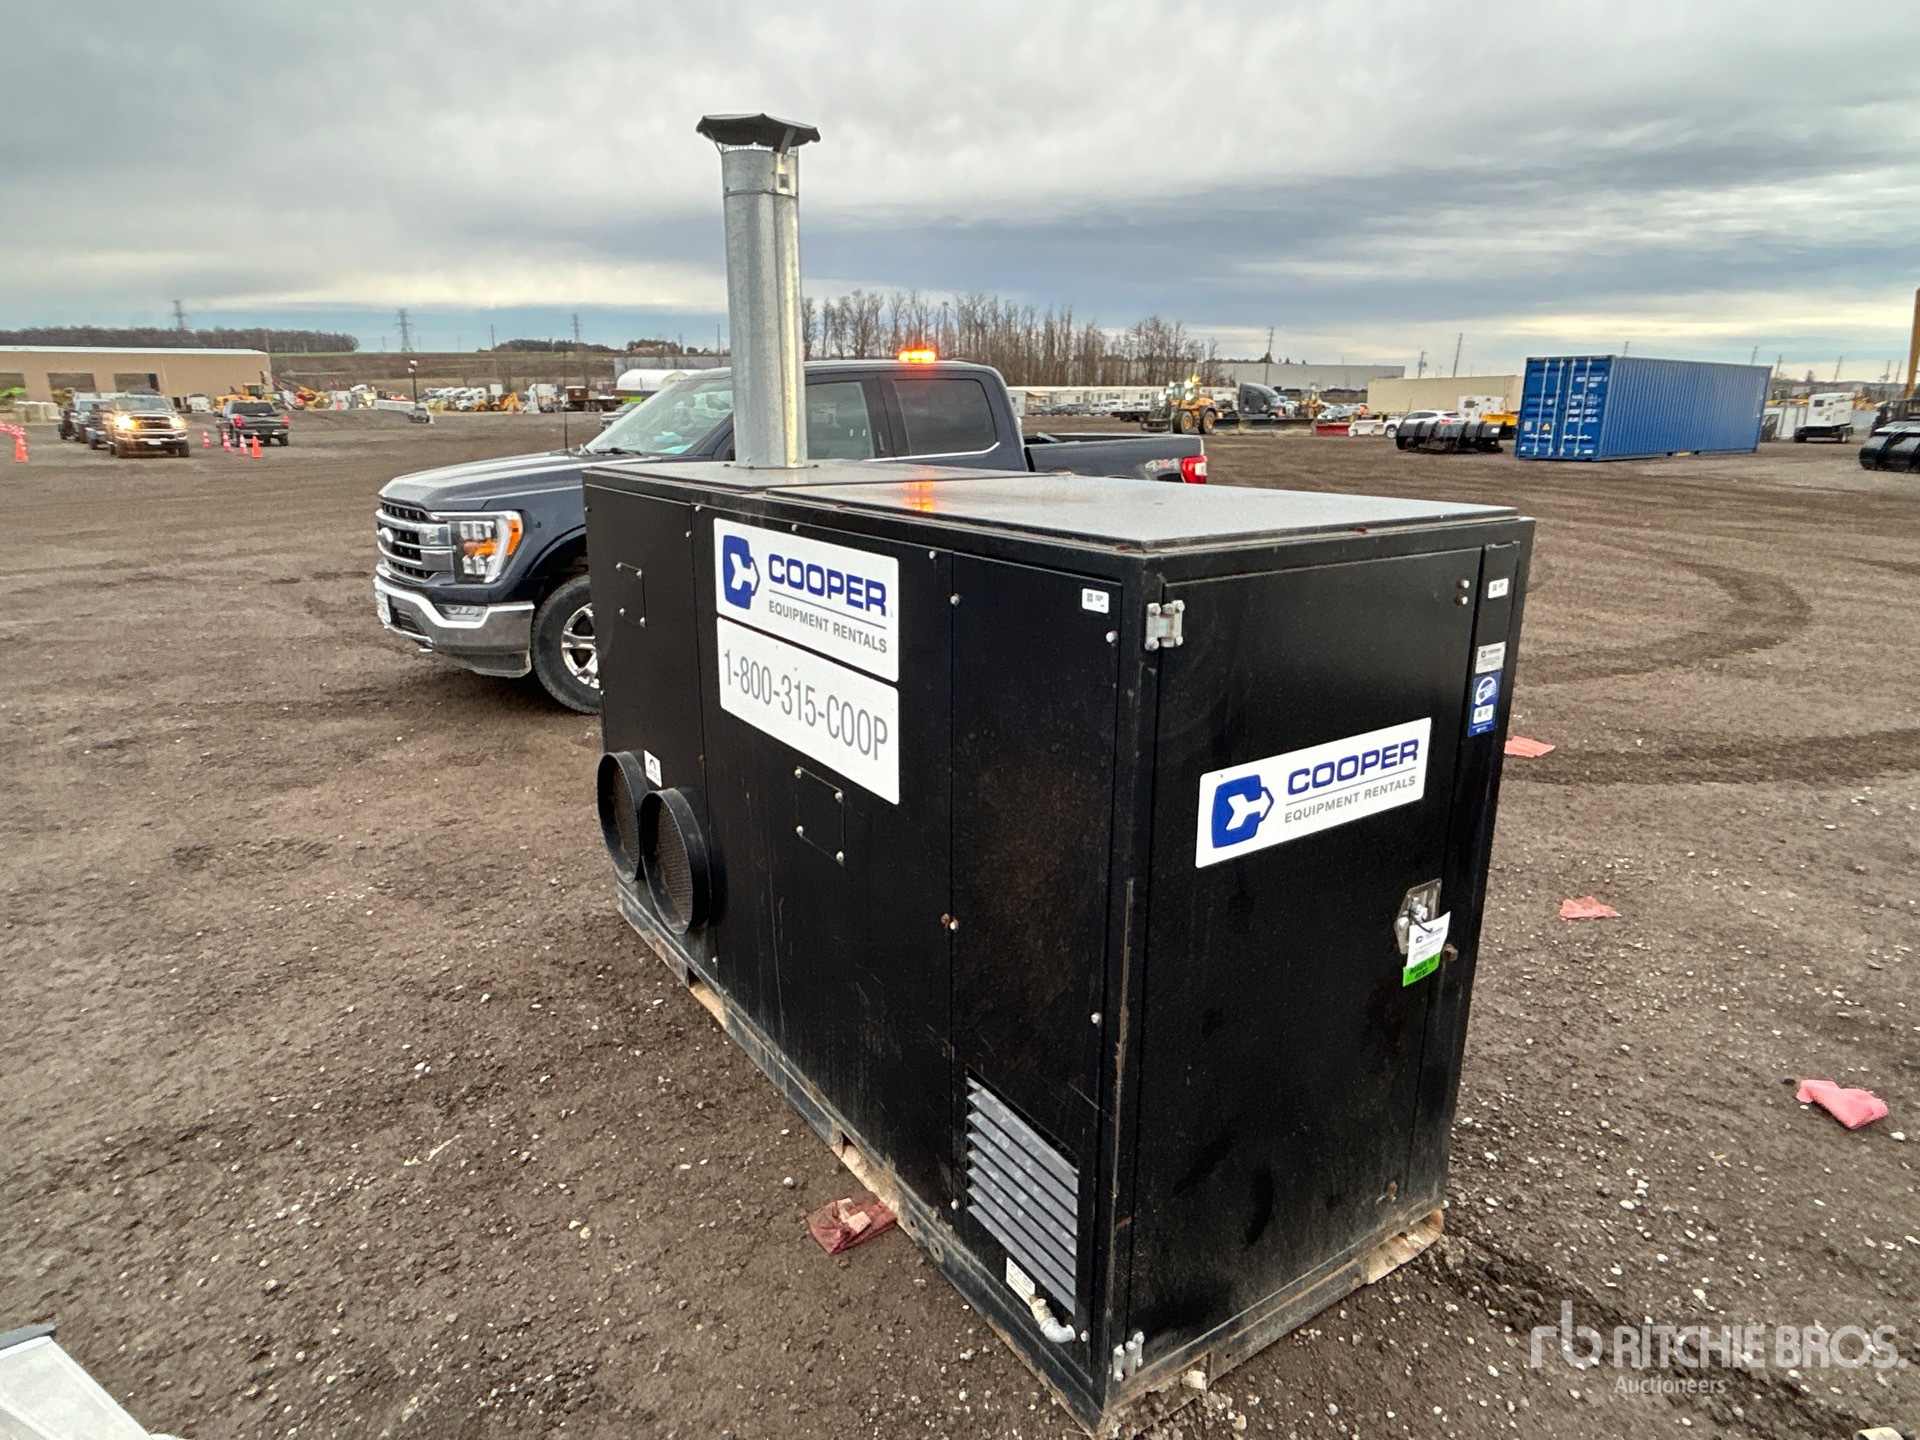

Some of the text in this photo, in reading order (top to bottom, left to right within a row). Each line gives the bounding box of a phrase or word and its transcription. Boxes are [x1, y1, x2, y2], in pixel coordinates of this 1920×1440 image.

[768, 553, 887, 616] COOPER
[768, 600, 887, 653] EQUIPMENT RENTALS
[724, 649, 888, 761] 1-800-315-COOP
[1287, 739, 1419, 795] COOPER
[1284, 775, 1416, 824] EQUIPMENT RENTALS
